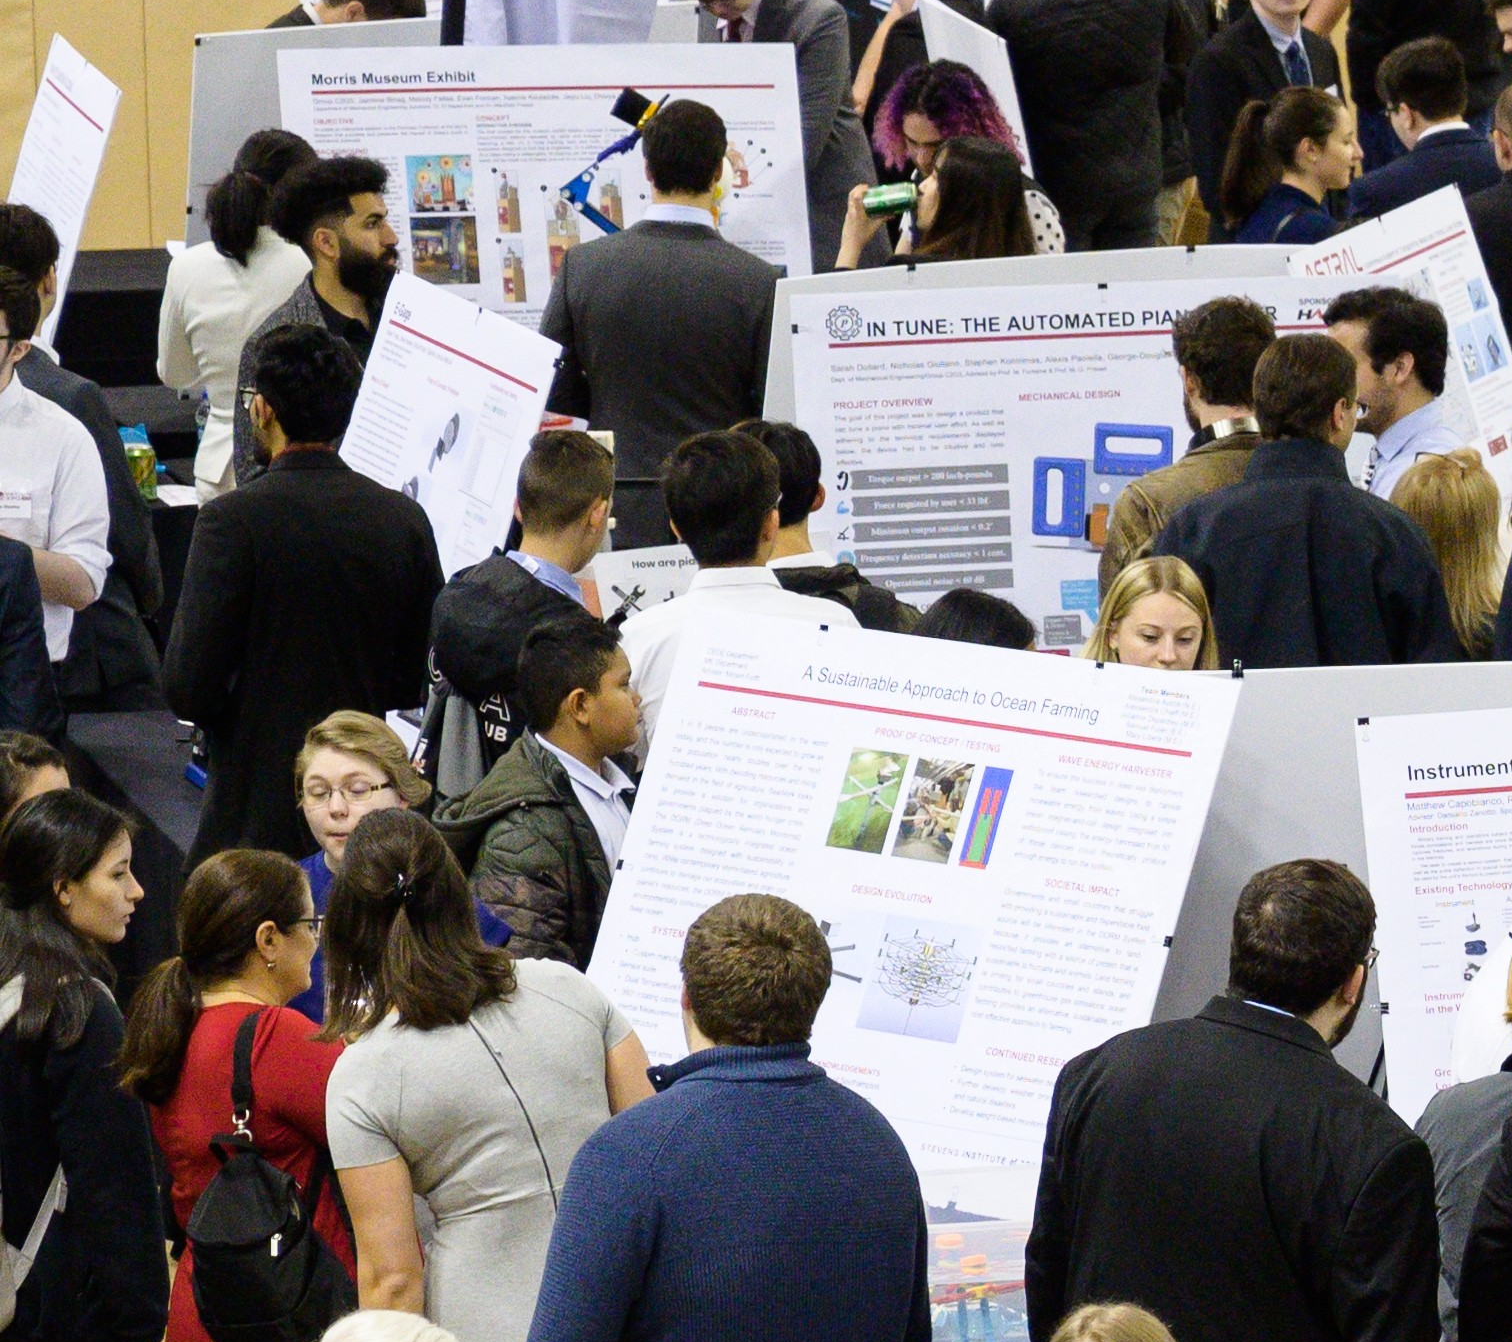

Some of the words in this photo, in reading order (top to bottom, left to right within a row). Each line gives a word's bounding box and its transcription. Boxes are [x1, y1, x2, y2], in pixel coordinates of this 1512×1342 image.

[312, 74, 357, 85] Morris
[362, 73, 422, 84] Museum
[427, 71, 475, 82] Exhibit
[867, 323, 886, 337] IN
[892, 318, 955, 336] TUNE:
[961, 315, 1000, 333] THE
[1007, 311, 1134, 331] AUTOMATED
[1143, 309, 1189, 327] PIAN
[1018, 392, 1081, 401] MECHANICAL
[1085, 390, 1121, 399] DESIGN
[833, 400, 878, 409] PROJECT
[881, 398, 933, 407] OVERVIEW
[802, 665, 813, 681] A
[817, 667, 899, 693] Sustainable
[901, 679, 969, 702] Approach
[972, 690, 986, 705] to
[990, 691, 1037, 712] Ocean
[1040, 698, 1100, 726] Farming
[731, 707, 776, 720] ABSTRACT
[1058, 755, 1082, 766] WAVE
[1084, 759, 1120, 770] ENERGY
[1121, 765, 1172, 778] HARVESTER
[1409, 823, 1468, 833] Introduction
[1415, 886, 1454, 895] Existing
[1458, 882, 1512, 891] Technology
